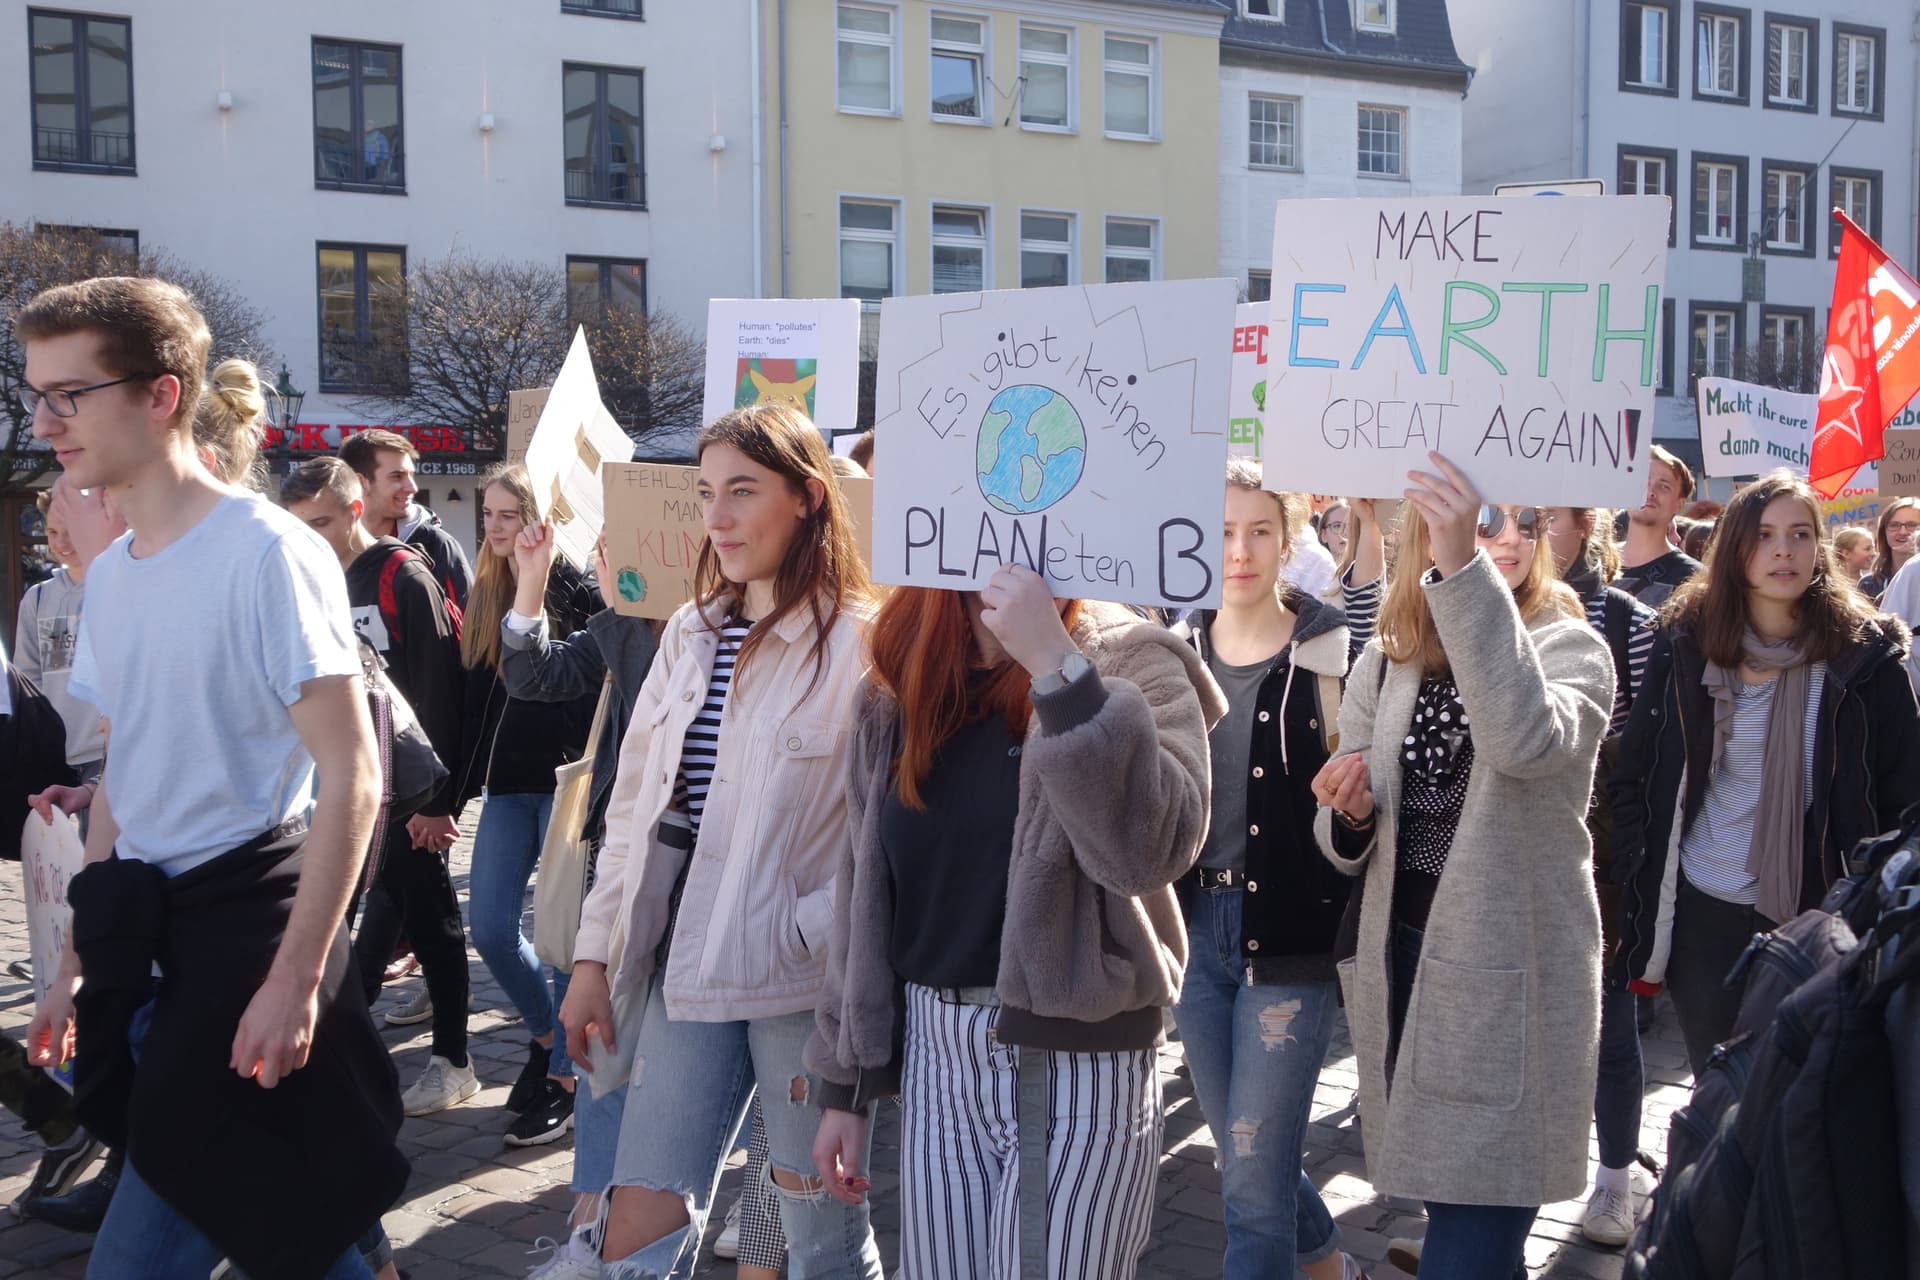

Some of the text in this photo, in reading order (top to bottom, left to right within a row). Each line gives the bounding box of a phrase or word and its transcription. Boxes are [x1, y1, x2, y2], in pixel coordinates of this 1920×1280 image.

[1375, 210, 1502, 262] MAKE
[738, 321, 771, 331] Human:
[738, 336, 763, 345] Earth:
[1288, 281, 1659, 387] EARTH
[917, 325, 1166, 471] Es gibt keinen
[1706, 386, 1753, 416] Macht
[1758, 397, 1778, 421] ihr
[1779, 413, 1808, 430] eure
[1321, 398, 1642, 473] GREAT AGAIN!
[1720, 429, 1760, 456] dann
[446, 463, 475, 474] 1968
[904, 506, 1213, 603] PLANeten B
